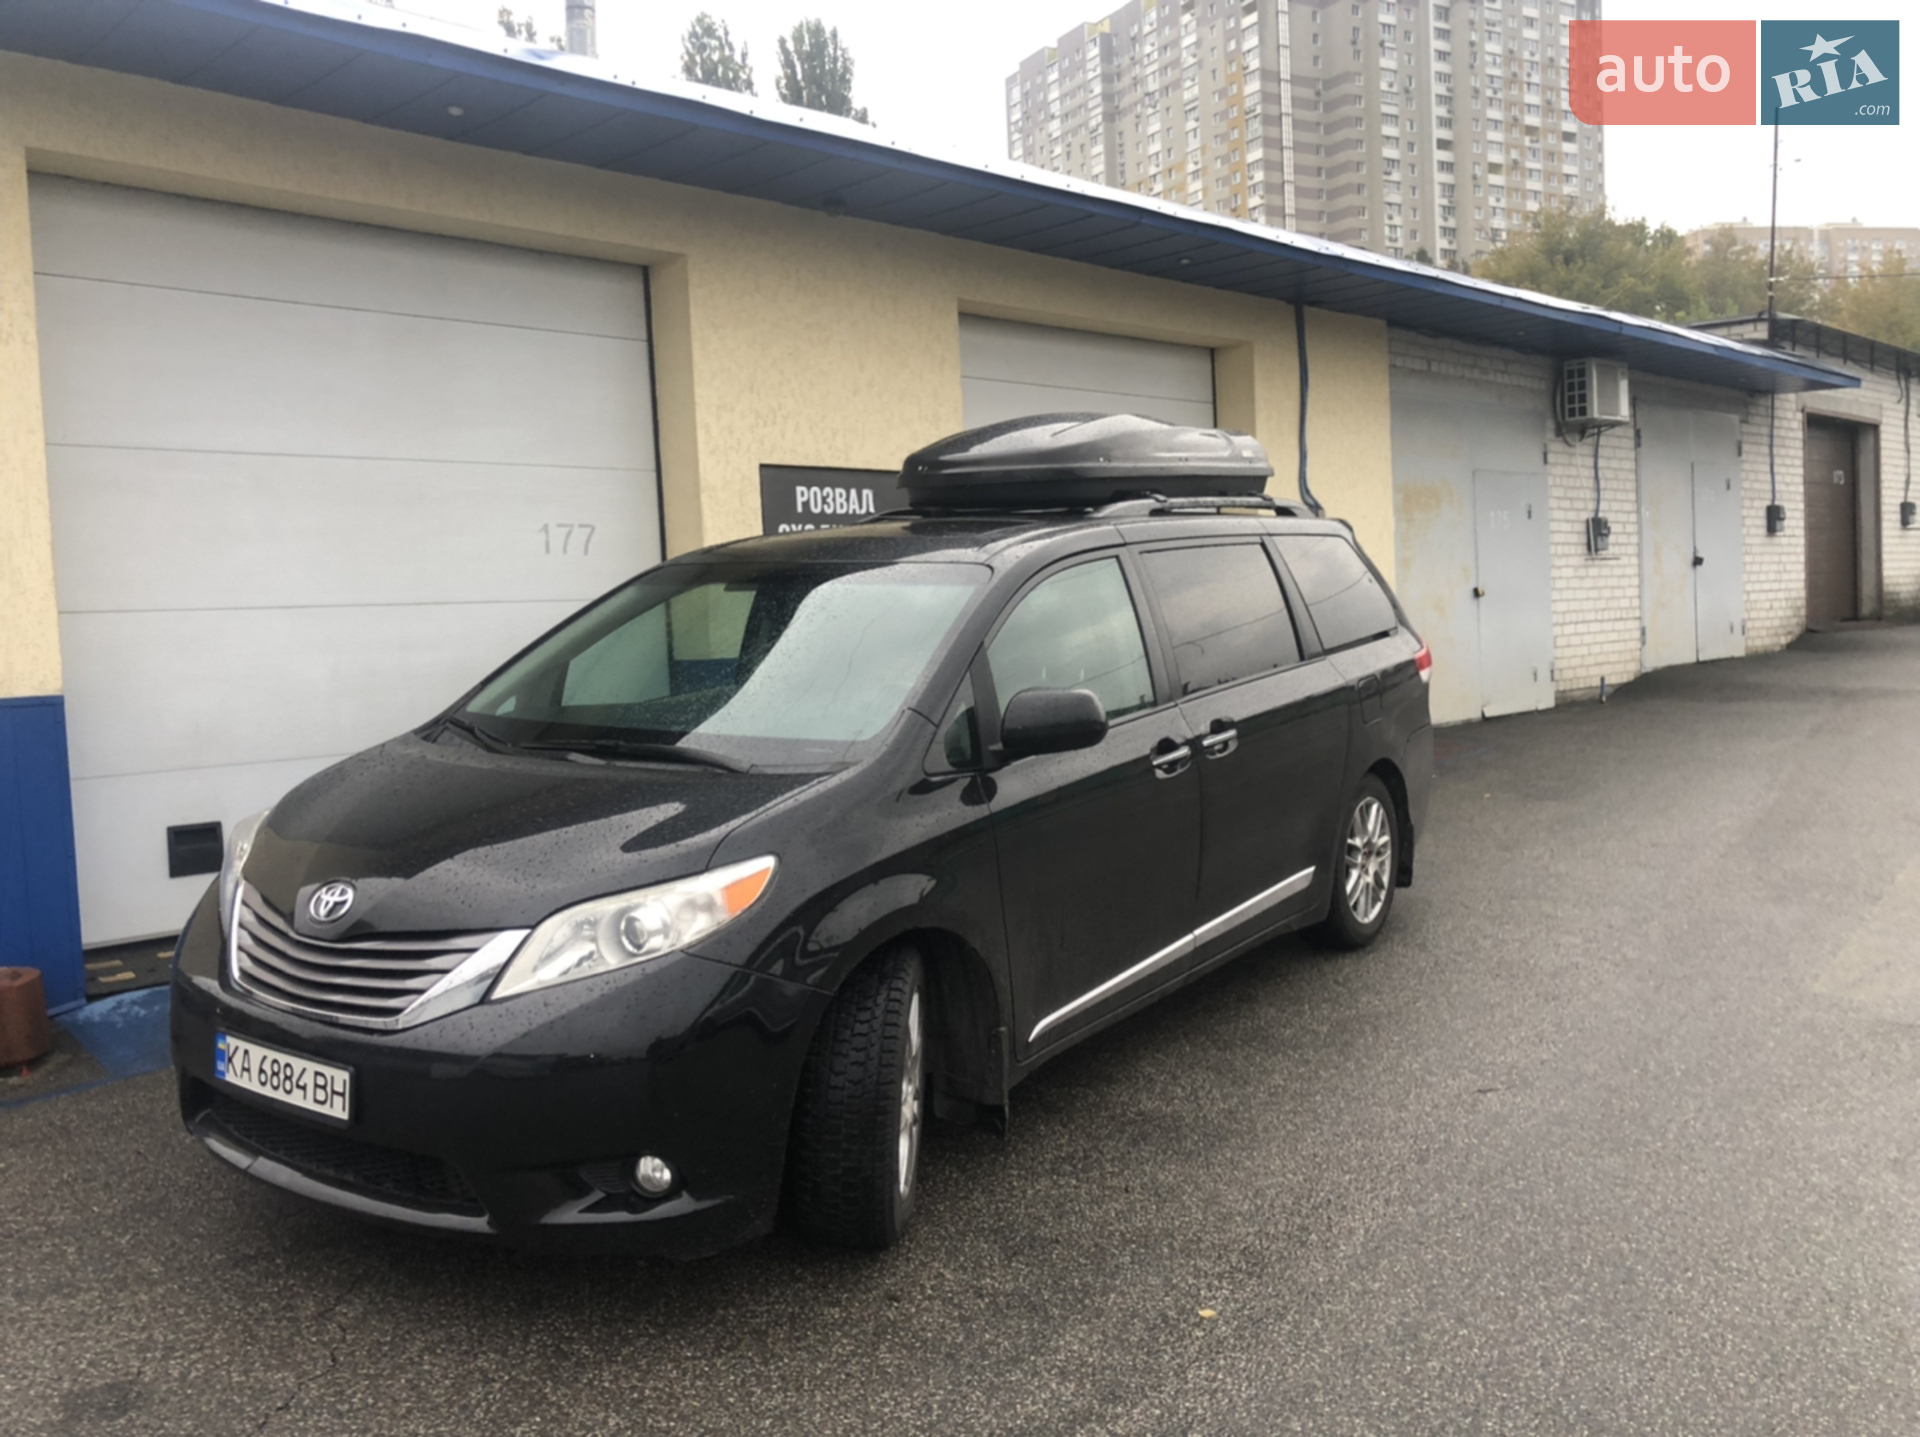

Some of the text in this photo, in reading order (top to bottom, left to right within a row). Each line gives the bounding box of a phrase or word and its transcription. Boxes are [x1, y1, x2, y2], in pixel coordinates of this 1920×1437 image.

[795, 485, 876, 515] РОЗВАЛ
[537, 522, 597, 556] 177
[226, 1041, 347, 1112] KA 6884 BH
